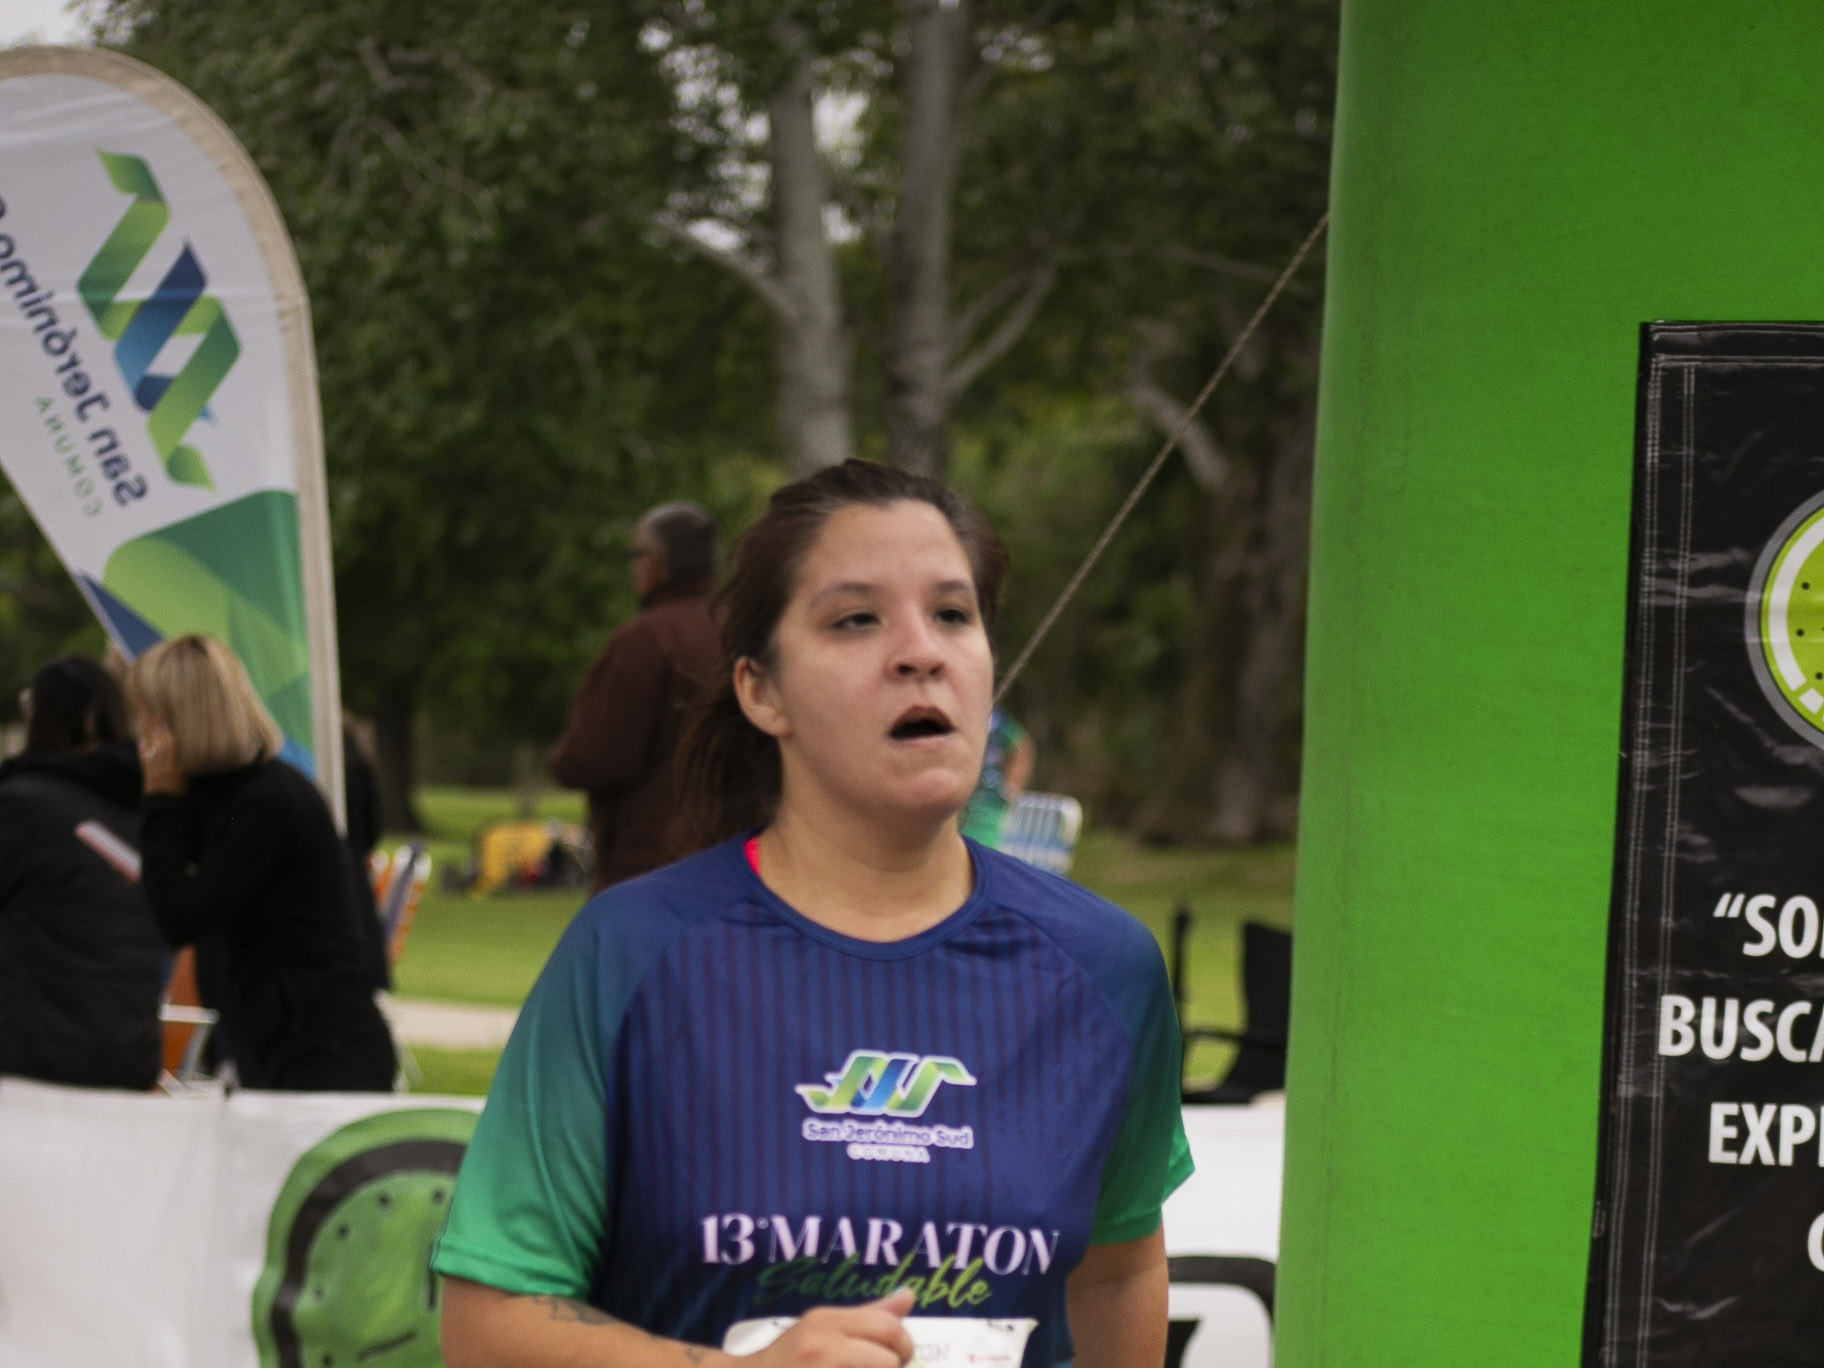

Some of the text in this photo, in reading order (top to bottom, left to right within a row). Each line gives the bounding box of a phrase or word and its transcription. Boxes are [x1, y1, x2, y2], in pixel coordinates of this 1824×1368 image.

[1713, 893, 1824, 959] “SO
[806, 1120, 842, 1140] San
[934, 1127, 971, 1148] Sud
[1708, 1102, 1824, 1168] EXP
